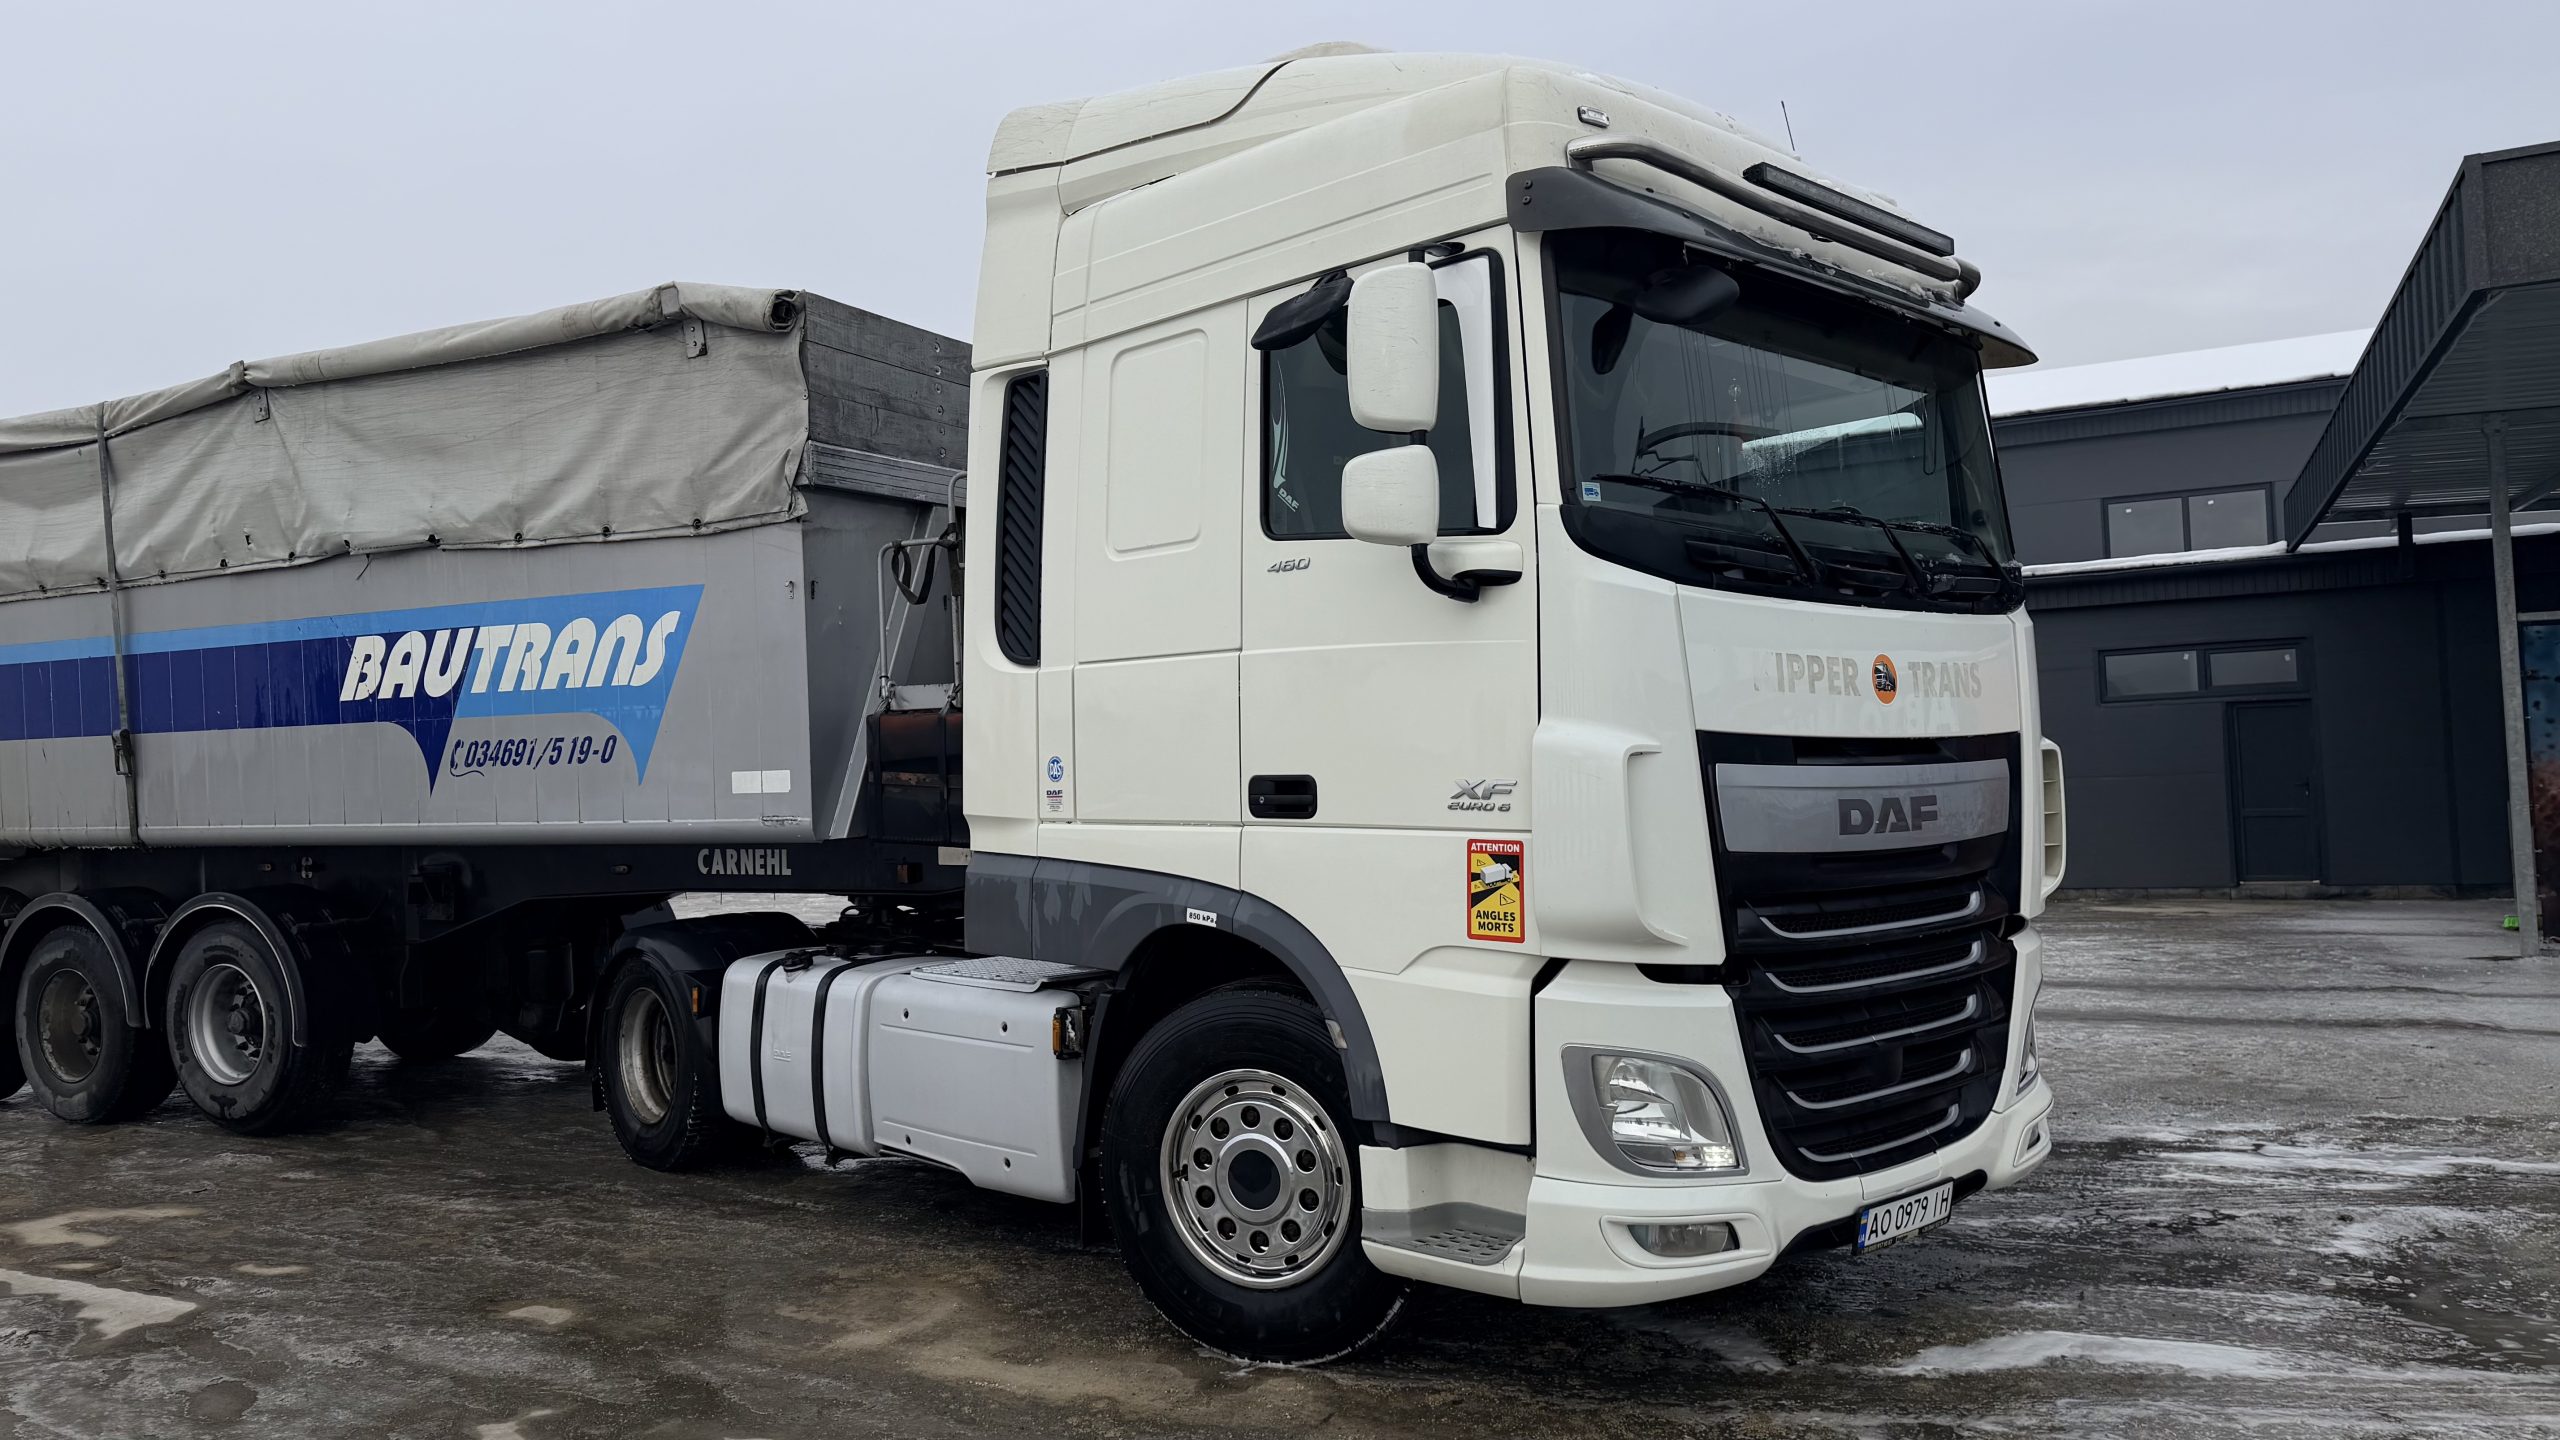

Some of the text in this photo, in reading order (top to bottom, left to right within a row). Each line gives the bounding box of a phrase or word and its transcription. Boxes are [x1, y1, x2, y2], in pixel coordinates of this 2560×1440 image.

[1278, 487, 1299, 509] DAF
[1267, 557, 1311, 573] 460
[340, 610, 681, 701] BAUTRANS
[1753, 651, 1983, 698] IPPER TRANS
[1450, 779, 1517, 800] XF
[1448, 802, 1511, 812] EURO 6
[1838, 795, 1938, 835] DAF
[1471, 842, 1520, 853] ATTENTION
[697, 848, 792, 876] CARNEHL
[1476, 910, 1516, 922] ANGLES
[1478, 921, 1514, 933] MORTS
[1868, 1209, 1892, 1240] AO
[1895, 1196, 1928, 1230] 0979
[1933, 1187, 1950, 1218] IH
